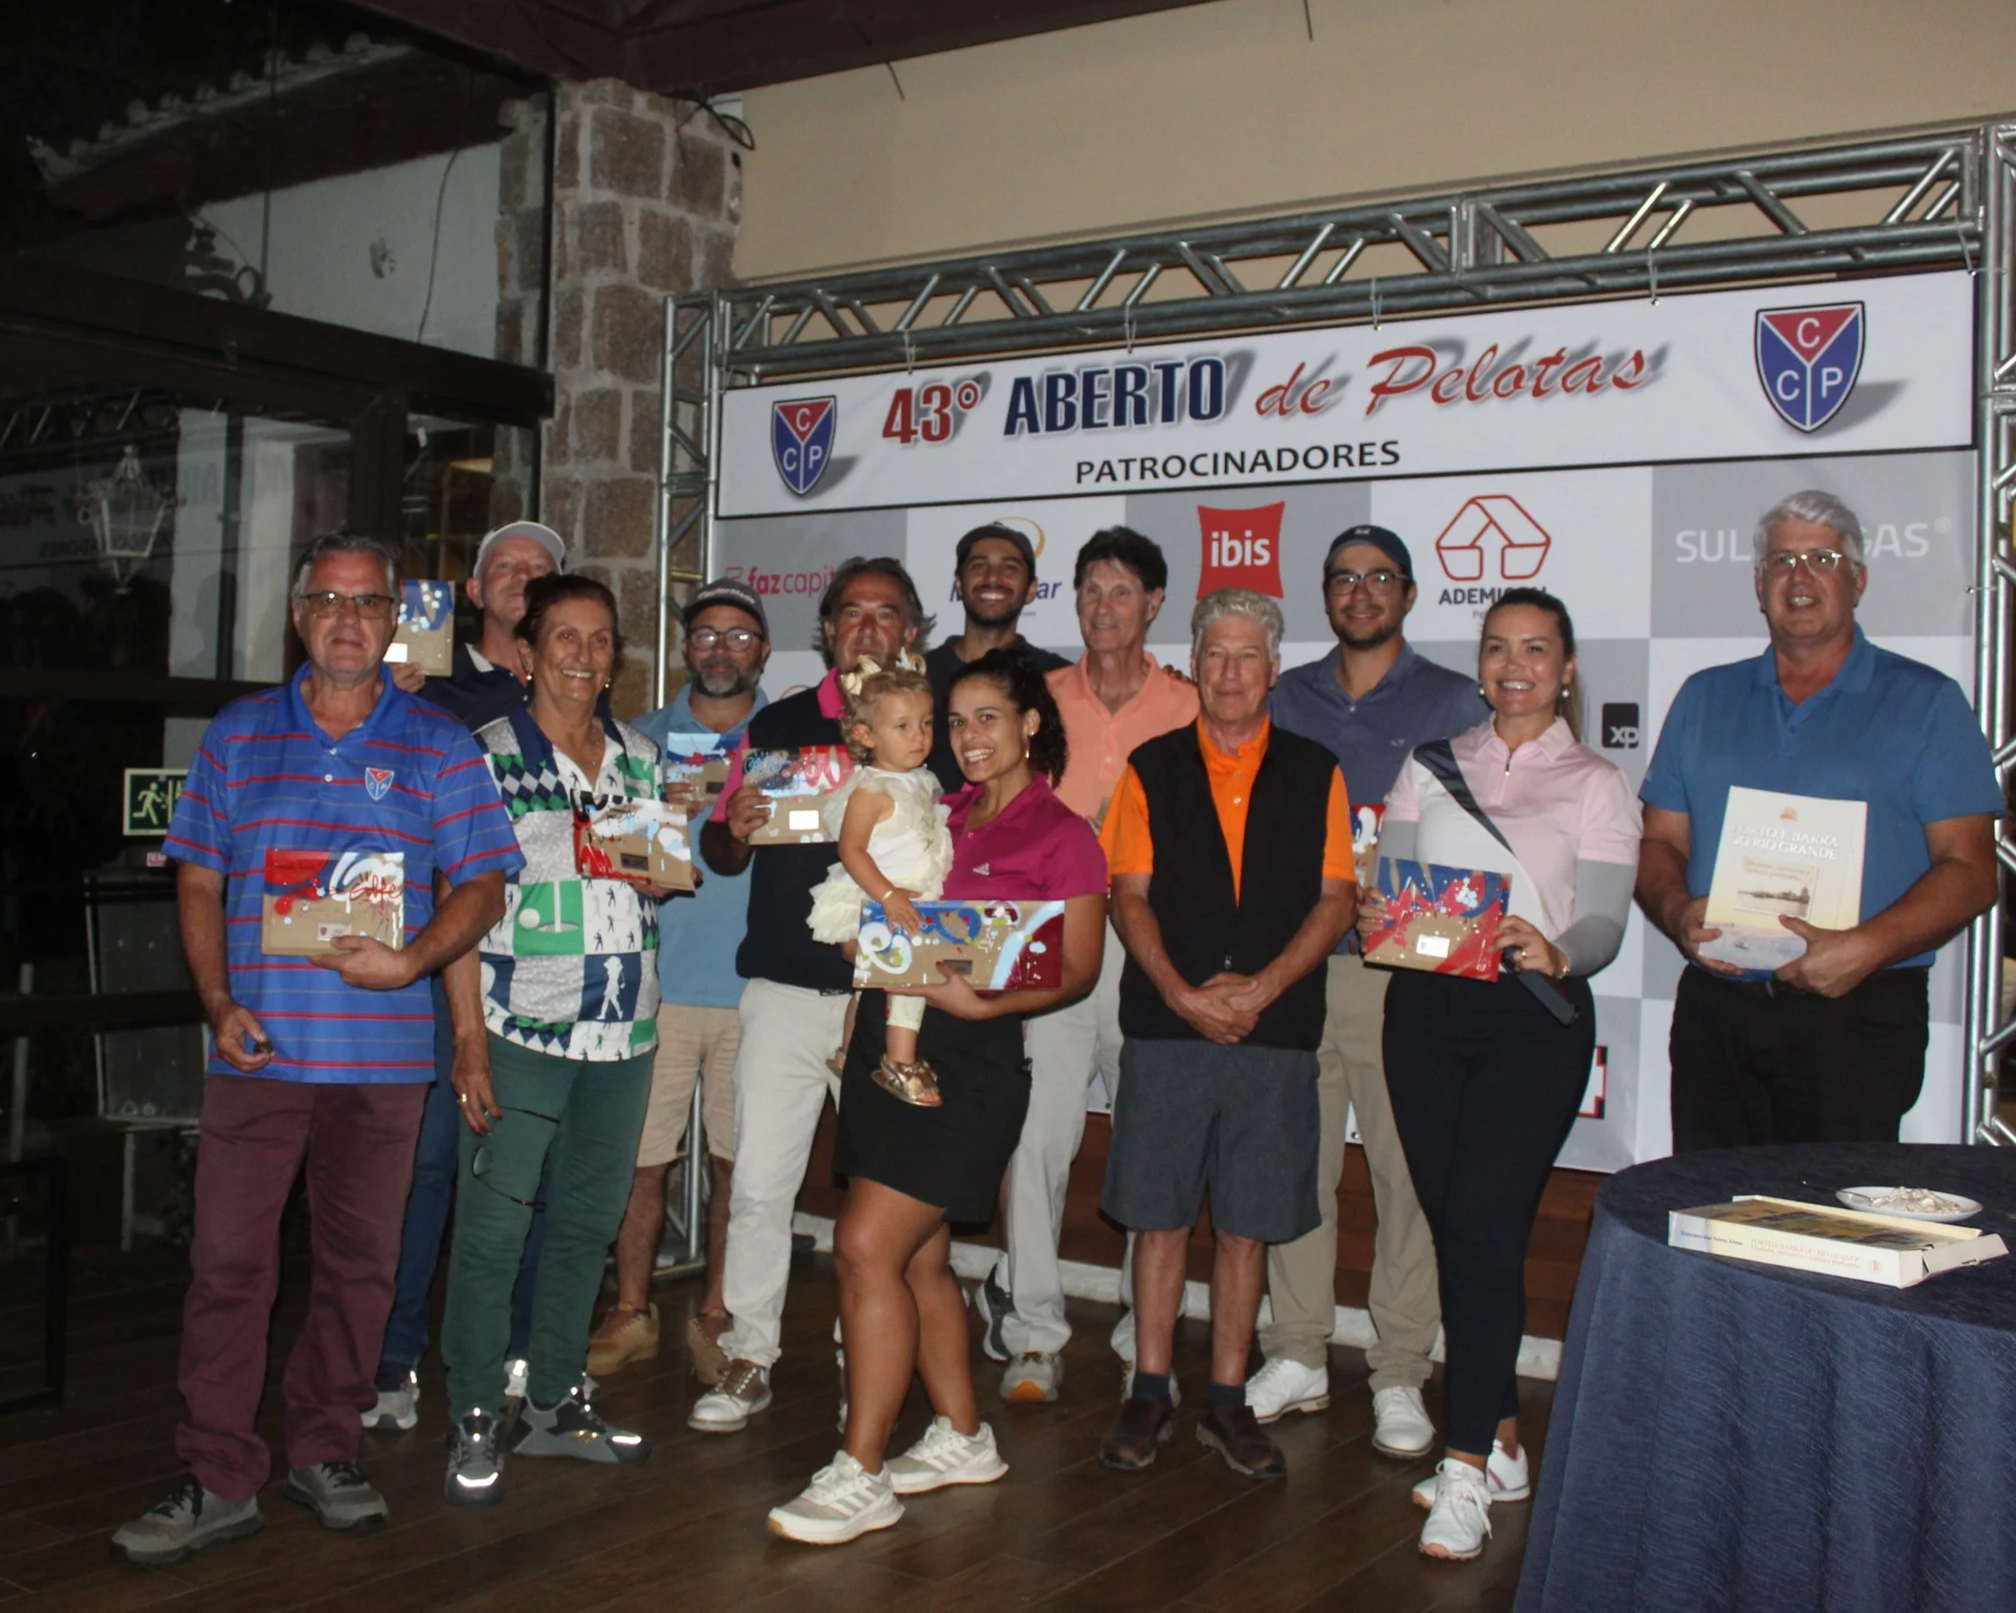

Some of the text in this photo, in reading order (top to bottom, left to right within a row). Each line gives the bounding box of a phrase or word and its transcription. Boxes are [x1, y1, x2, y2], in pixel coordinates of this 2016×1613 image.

[1796, 317, 1820, 348] C
[1003, 357, 1225, 436] ABERTO
[1255, 361, 1332, 417] de
[1365, 343, 1646, 417] Pelotas
[796, 407, 811, 431] C
[1076, 440, 1401, 485] PATROCINADORES
[1211, 529, 1271, 567] ibis
[747, 565, 838, 599] fazcapit
[1439, 586, 1547, 605] ADEMI
[1778, 842, 1838, 860] GRANDE
[1792, 830, 1838, 848] BARRA
